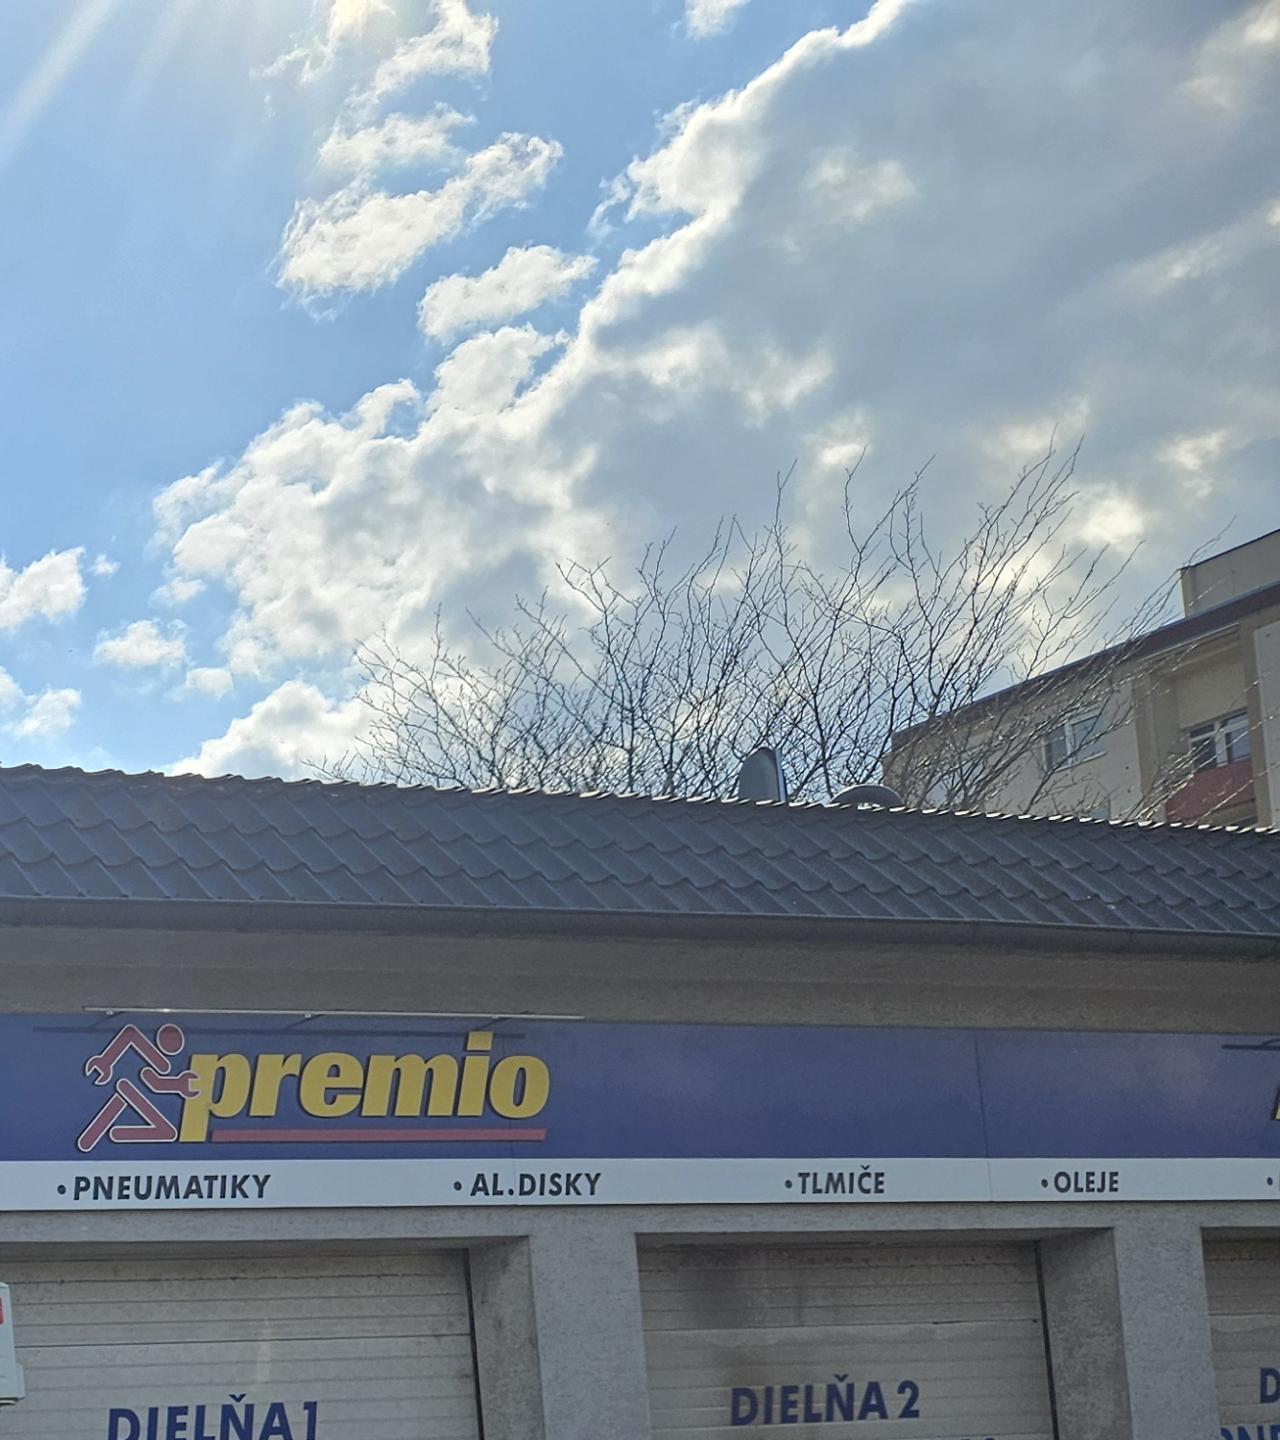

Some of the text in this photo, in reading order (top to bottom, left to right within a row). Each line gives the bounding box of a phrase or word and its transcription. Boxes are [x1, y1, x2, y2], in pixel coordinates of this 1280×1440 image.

[178, 1031, 550, 1143] premio
[73, 1174, 272, 1201] PNEUMATIKY
[469, 1172, 602, 1197] AL.DISKY
[798, 1164, 886, 1194] TLMIČE
[1053, 1171, 1120, 1194] OLEJE
[729, 1374, 921, 1427] DIELŇA 2
